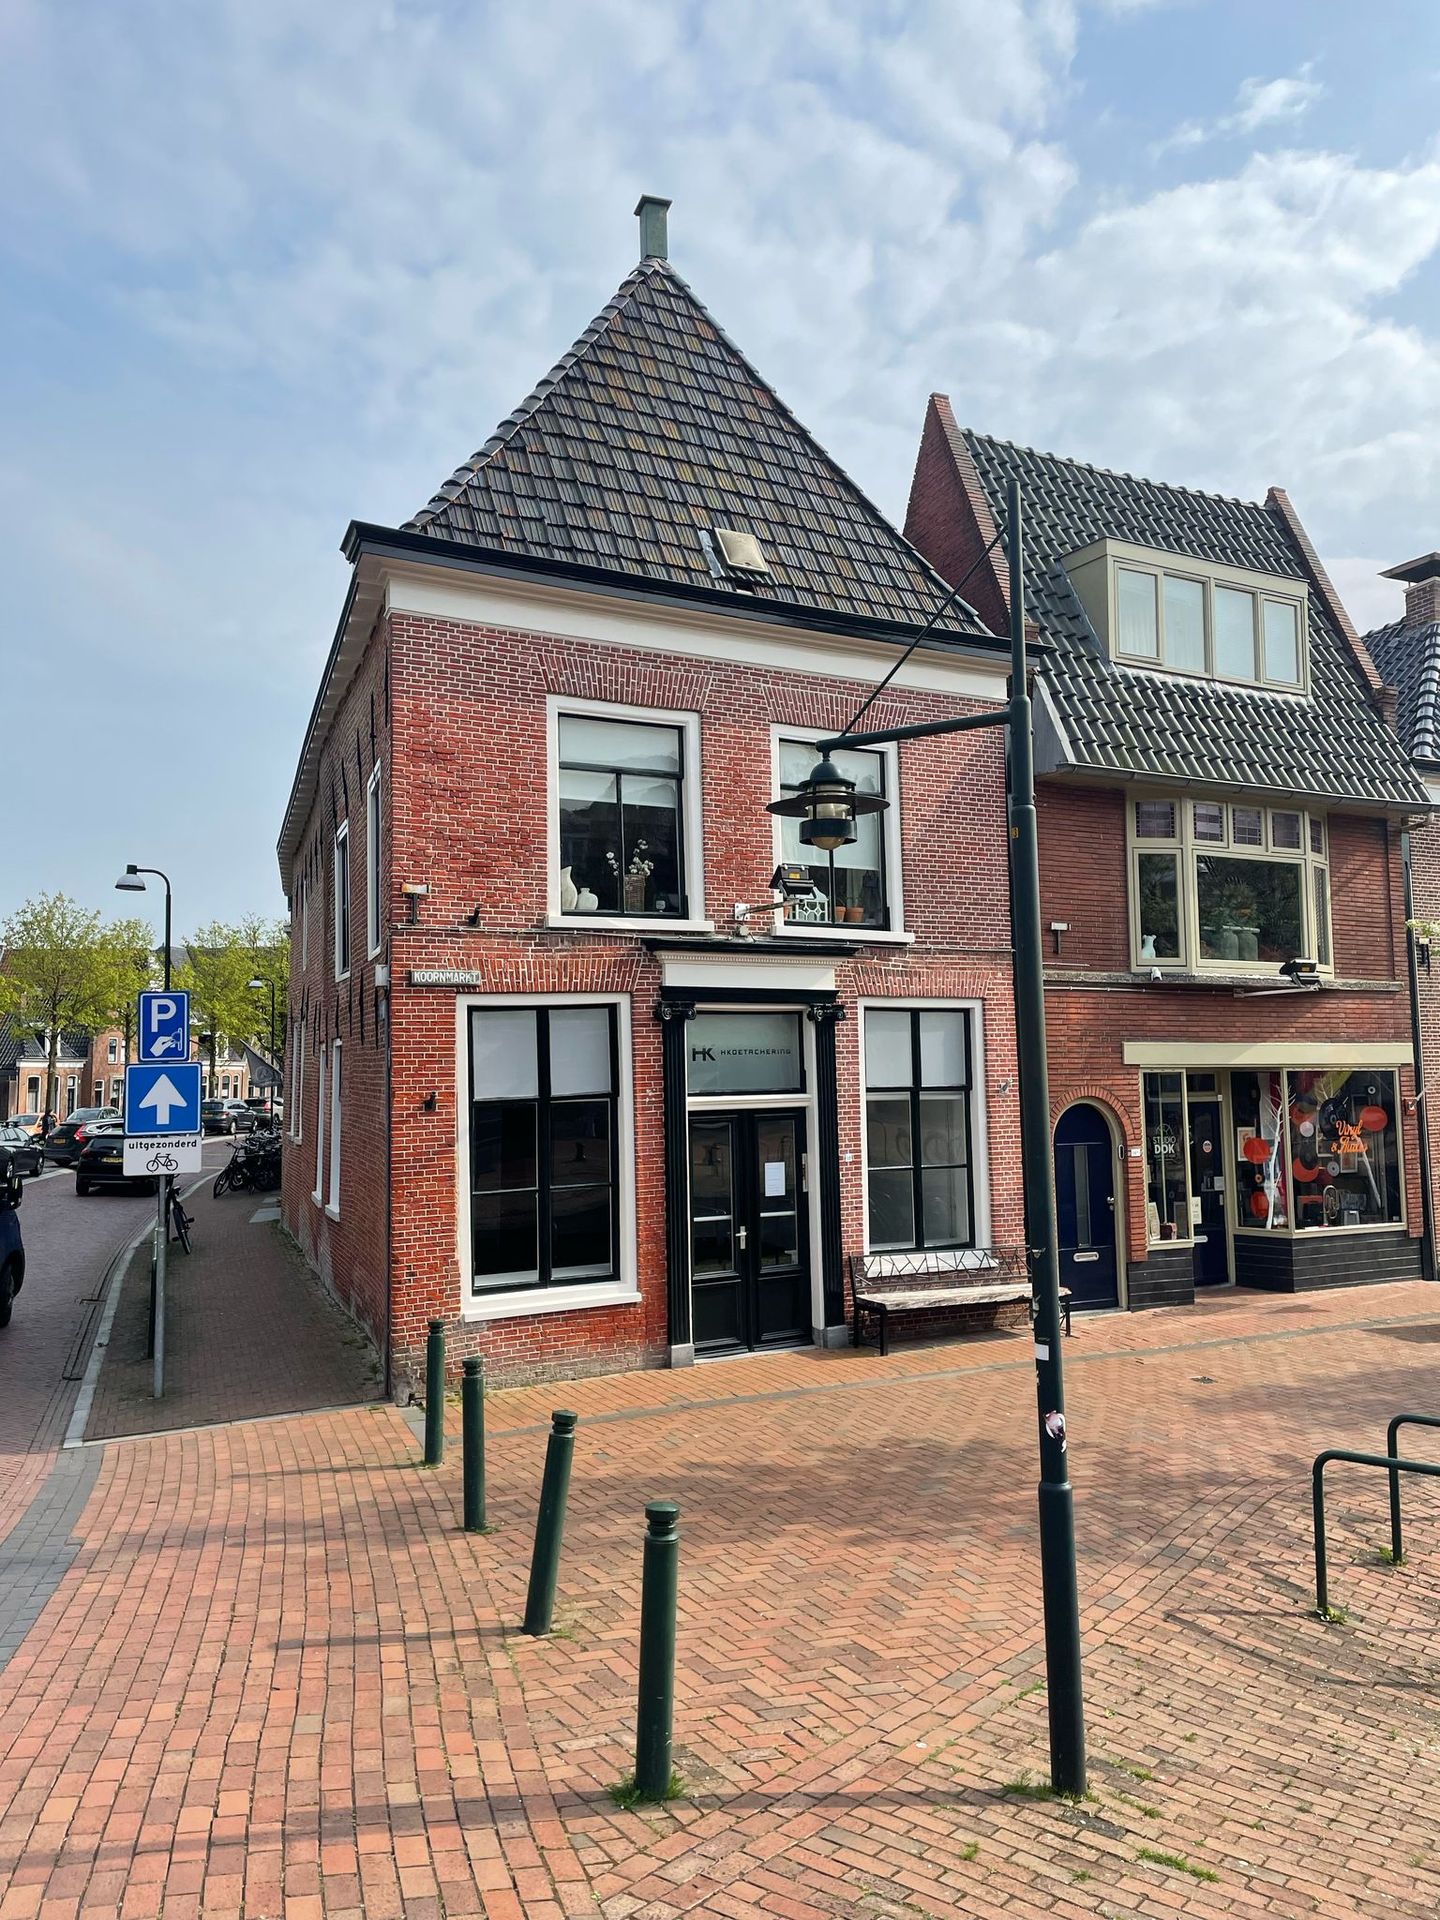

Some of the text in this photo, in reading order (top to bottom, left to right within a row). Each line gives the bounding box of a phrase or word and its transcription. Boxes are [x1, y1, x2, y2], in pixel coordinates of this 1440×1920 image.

[414, 971, 478, 983] KOORNMARKT
[151, 998, 177, 1033] P
[692, 1047, 716, 1061] HK
[128, 1139, 197, 1151] uitgezonderd
[1154, 1144, 1175, 1154] DOK
